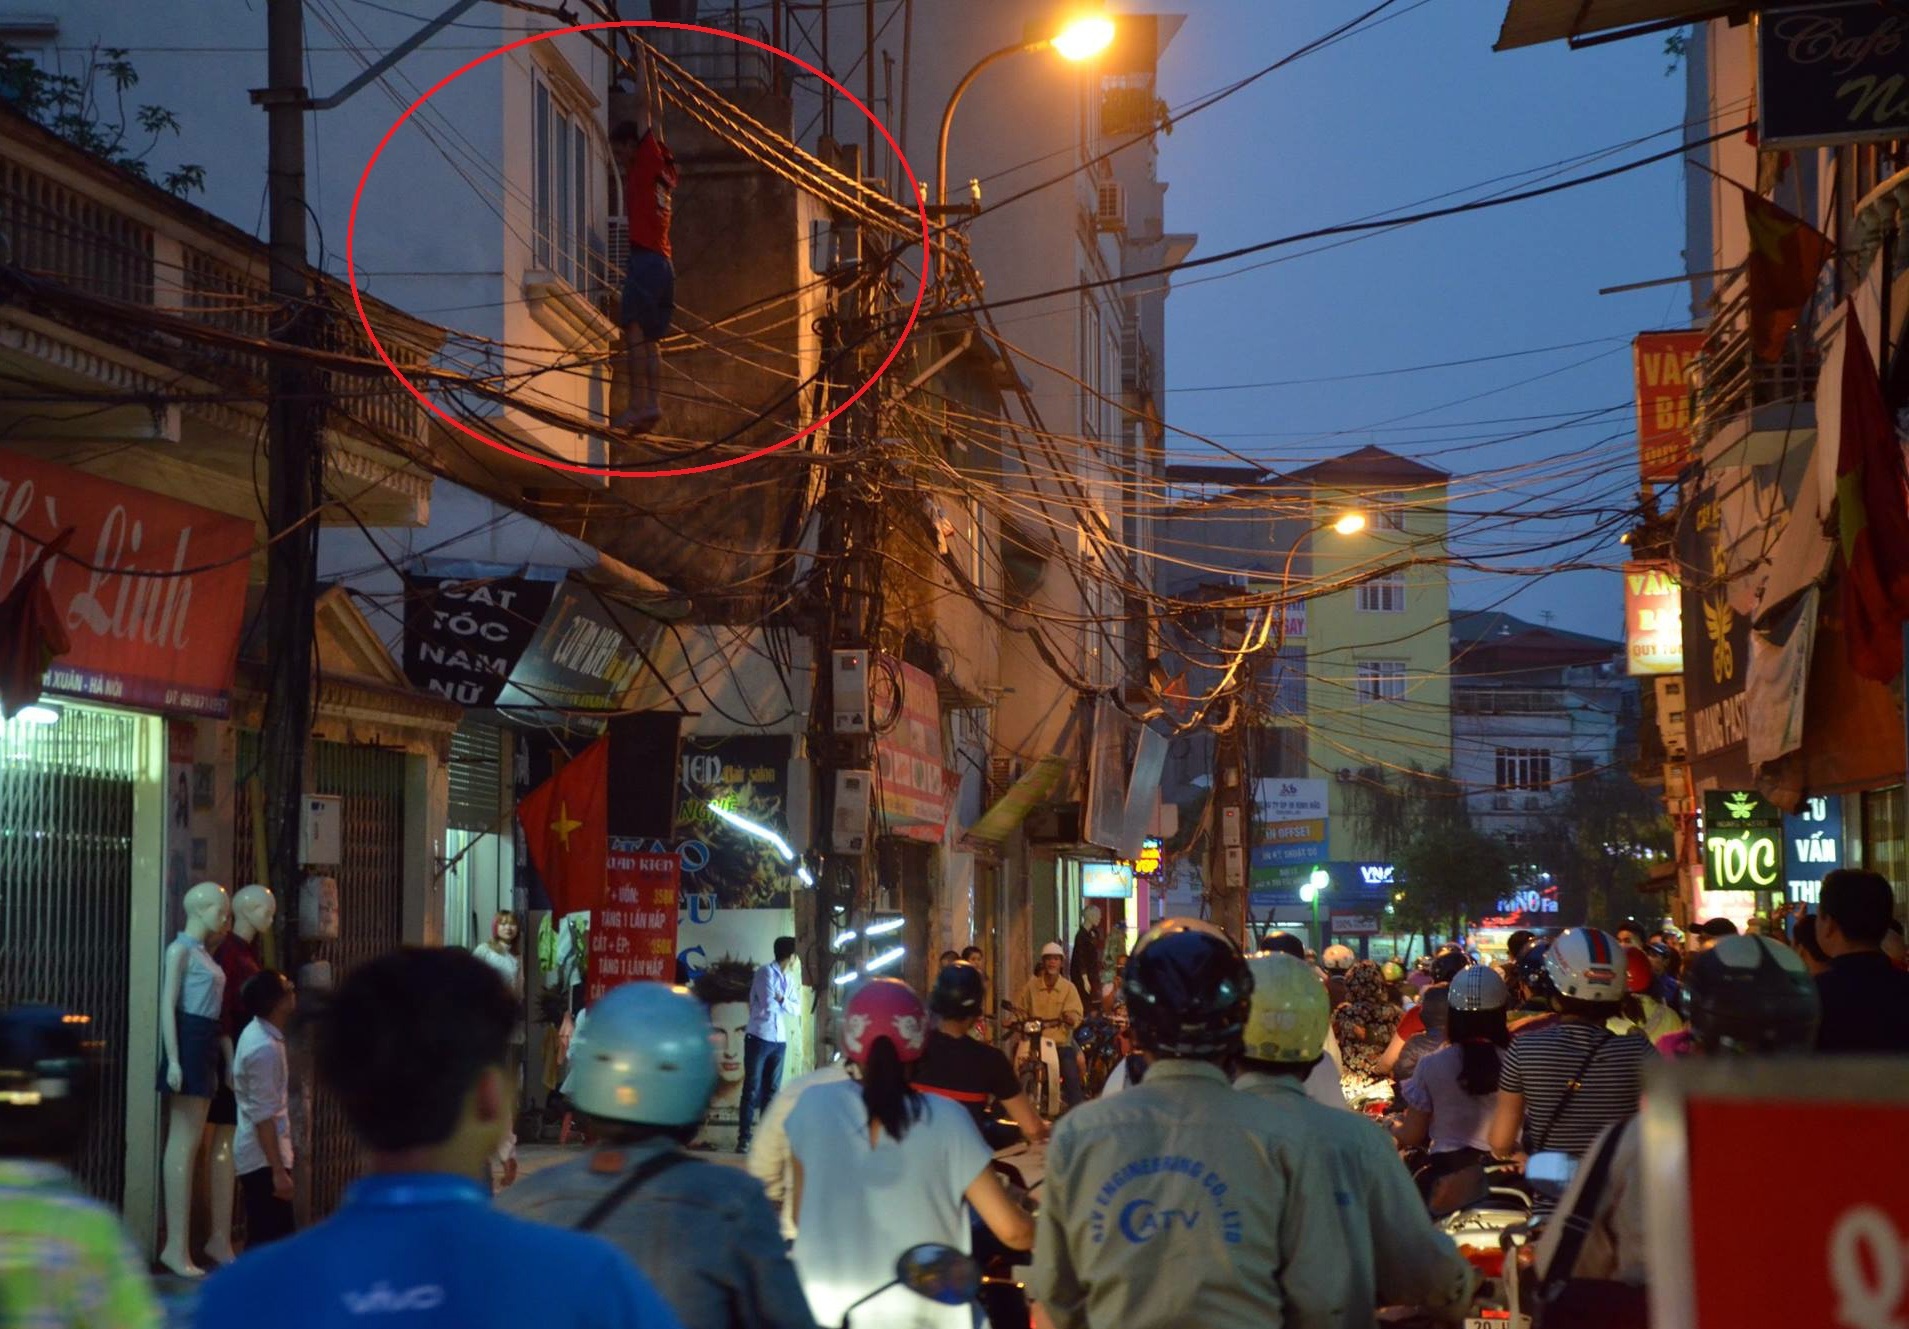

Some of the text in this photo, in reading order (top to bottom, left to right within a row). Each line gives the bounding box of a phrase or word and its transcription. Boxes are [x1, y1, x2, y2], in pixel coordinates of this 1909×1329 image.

[66, 503, 193, 650] Linh
[419, 642, 508, 677] NAM
[1707, 830, 1777, 887] TÓC
[1795, 830, 1837, 863] VẤN
